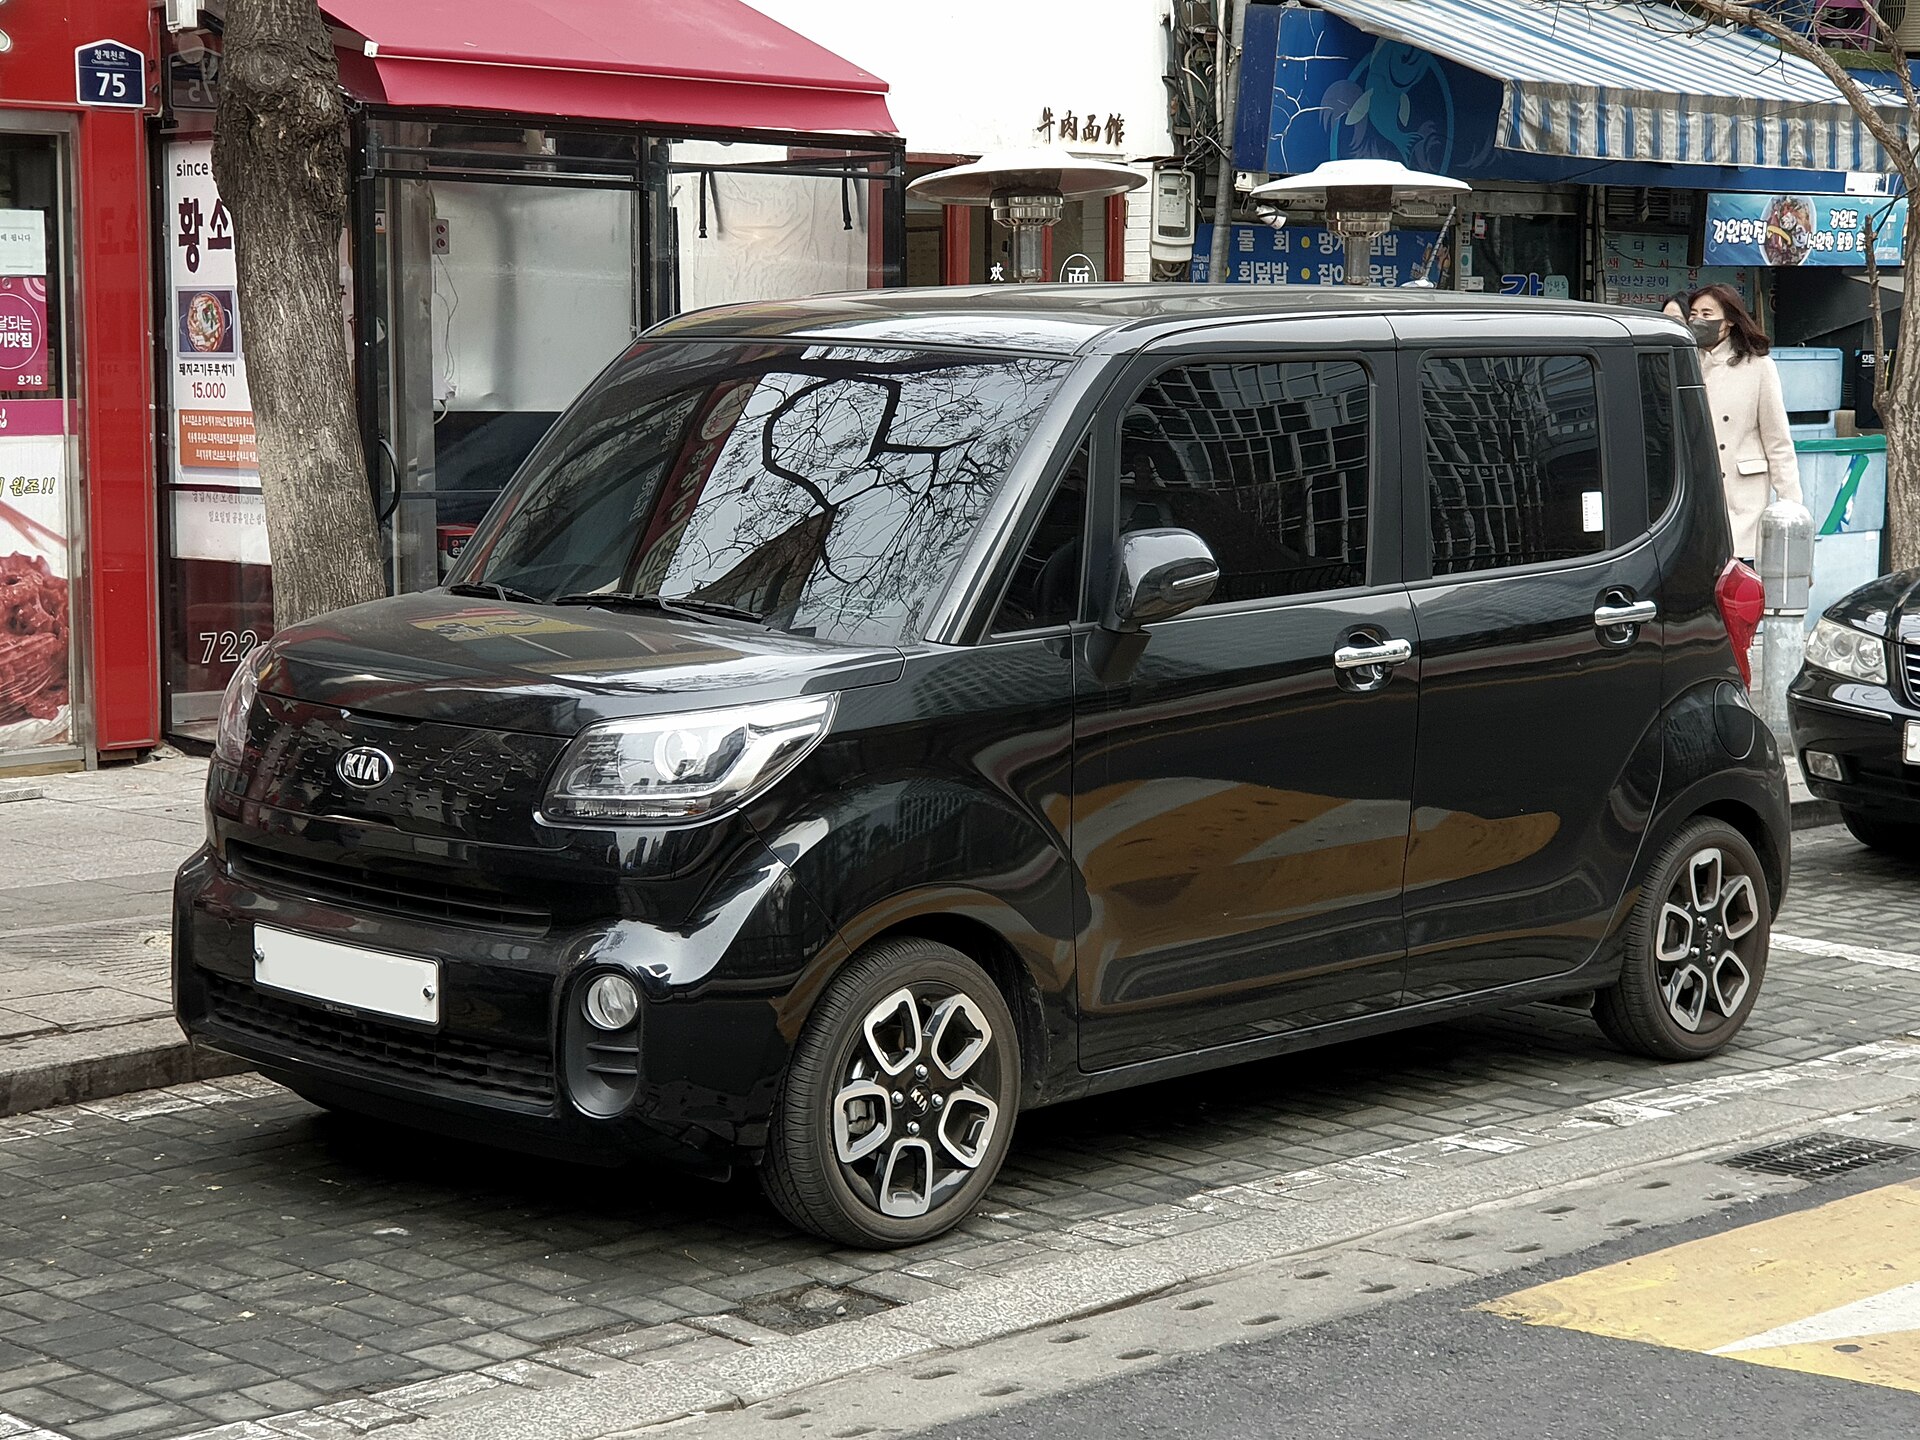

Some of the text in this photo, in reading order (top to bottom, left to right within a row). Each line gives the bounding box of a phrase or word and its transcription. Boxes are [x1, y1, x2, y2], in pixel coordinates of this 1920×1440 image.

[94, 49, 127, 61] 청계천로
[96, 72, 127, 98] 75
[1036, 106, 1126, 146] 牛肉面馆
[176, 159, 209, 177] since
[1829, 208, 1858, 229] 강원도
[178, 197, 232, 273] 황소
[1237, 261, 1289, 285] 회덮밥
[1607, 274, 1669, 288] 자연산광어
[17, 375, 43, 386] 요기요
[191, 382, 227, 399] 15.000
[9, 477, 56, 497] 원조!!
[343, 753, 380, 782] KIA
[910, 1088, 928, 1112] KIA
